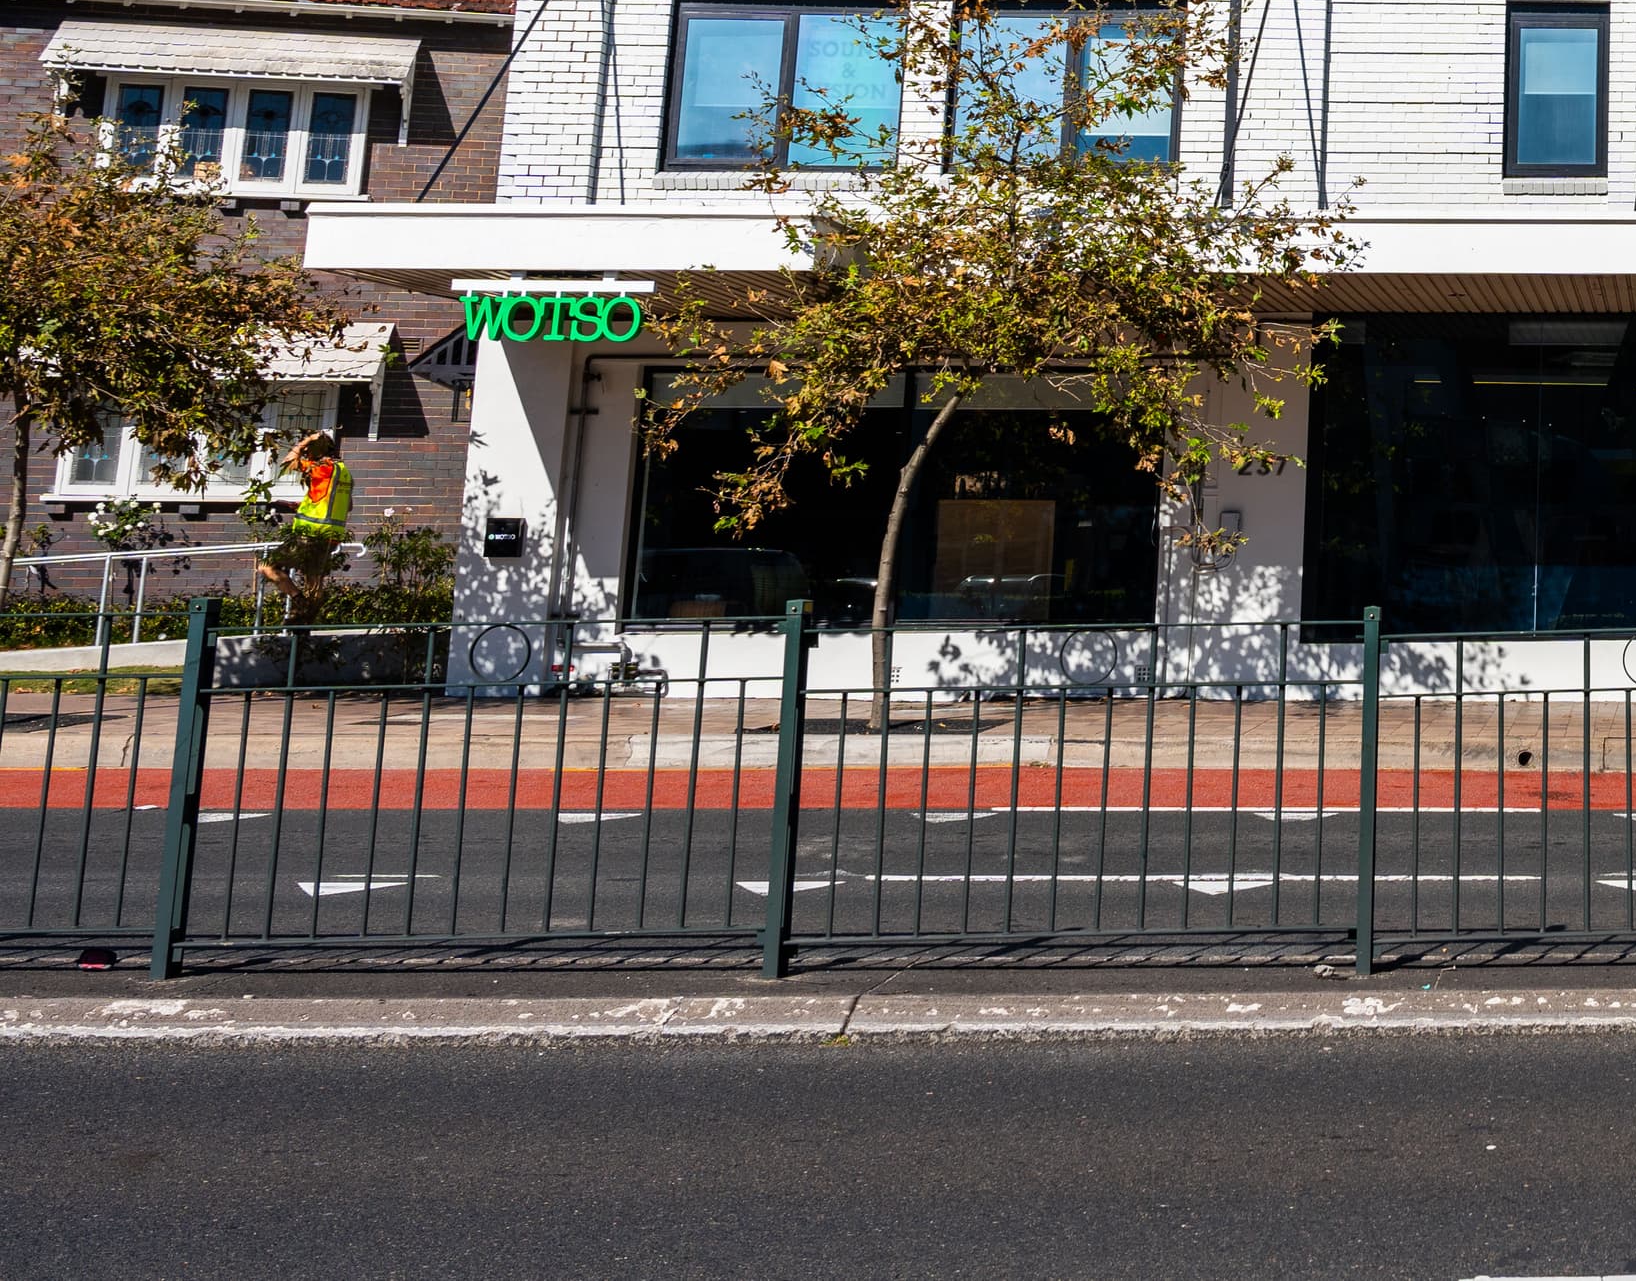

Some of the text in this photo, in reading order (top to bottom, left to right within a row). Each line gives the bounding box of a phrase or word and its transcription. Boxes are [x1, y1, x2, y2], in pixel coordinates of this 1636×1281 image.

[842, 62, 856, 78] &
[811, 83, 887, 100] SION
[459, 296, 644, 343] WOTSO
